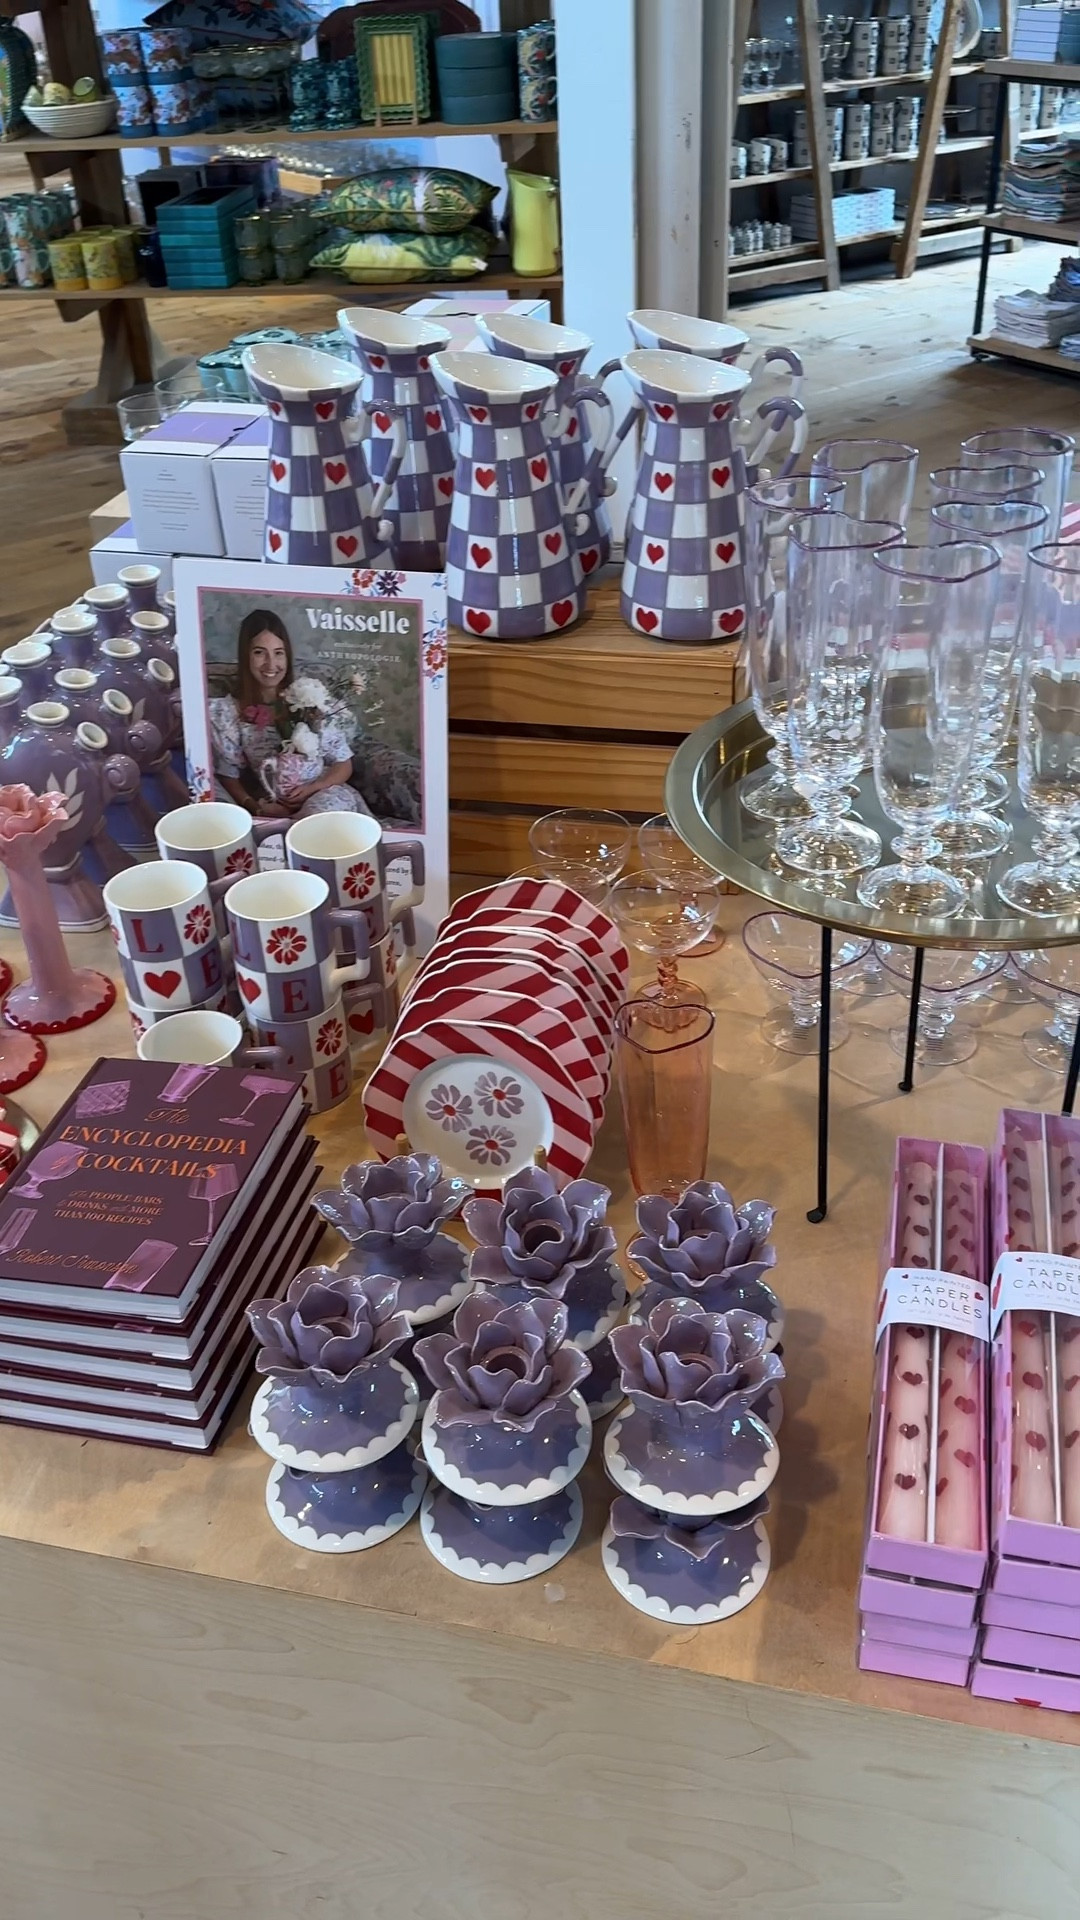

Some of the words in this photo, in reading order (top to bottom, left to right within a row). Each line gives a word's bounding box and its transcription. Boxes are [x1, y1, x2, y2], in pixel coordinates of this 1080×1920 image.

[305, 607, 410, 634] Vaisselle
[317, 651, 401, 662] ANTHROPOLOGIE
[131, 918, 164, 952] L
[201, 948, 220, 988] E
[282, 979, 309, 1014] E
[329, 1061, 348, 1098] E
[144, 1107, 190, 1124] The
[59, 1125, 247, 1156] ENCYCLOPEDIA
[76, 1152, 217, 1180] COCKTAILS
[66, 1200, 109, 1211] DRINKS
[129, 1205, 164, 1216] MORE
[133, 1195, 163, 1205] BARS
[54, 1209, 84, 1219] THAN
[105, 1214, 154, 1226] RECIPES
[5, 1248, 62, 1266] Robert
[912, 1283, 969, 1302] TAPER
[937, 1278, 971, 1291] PAINTED
[897, 1294, 982, 1319] CANDLES
